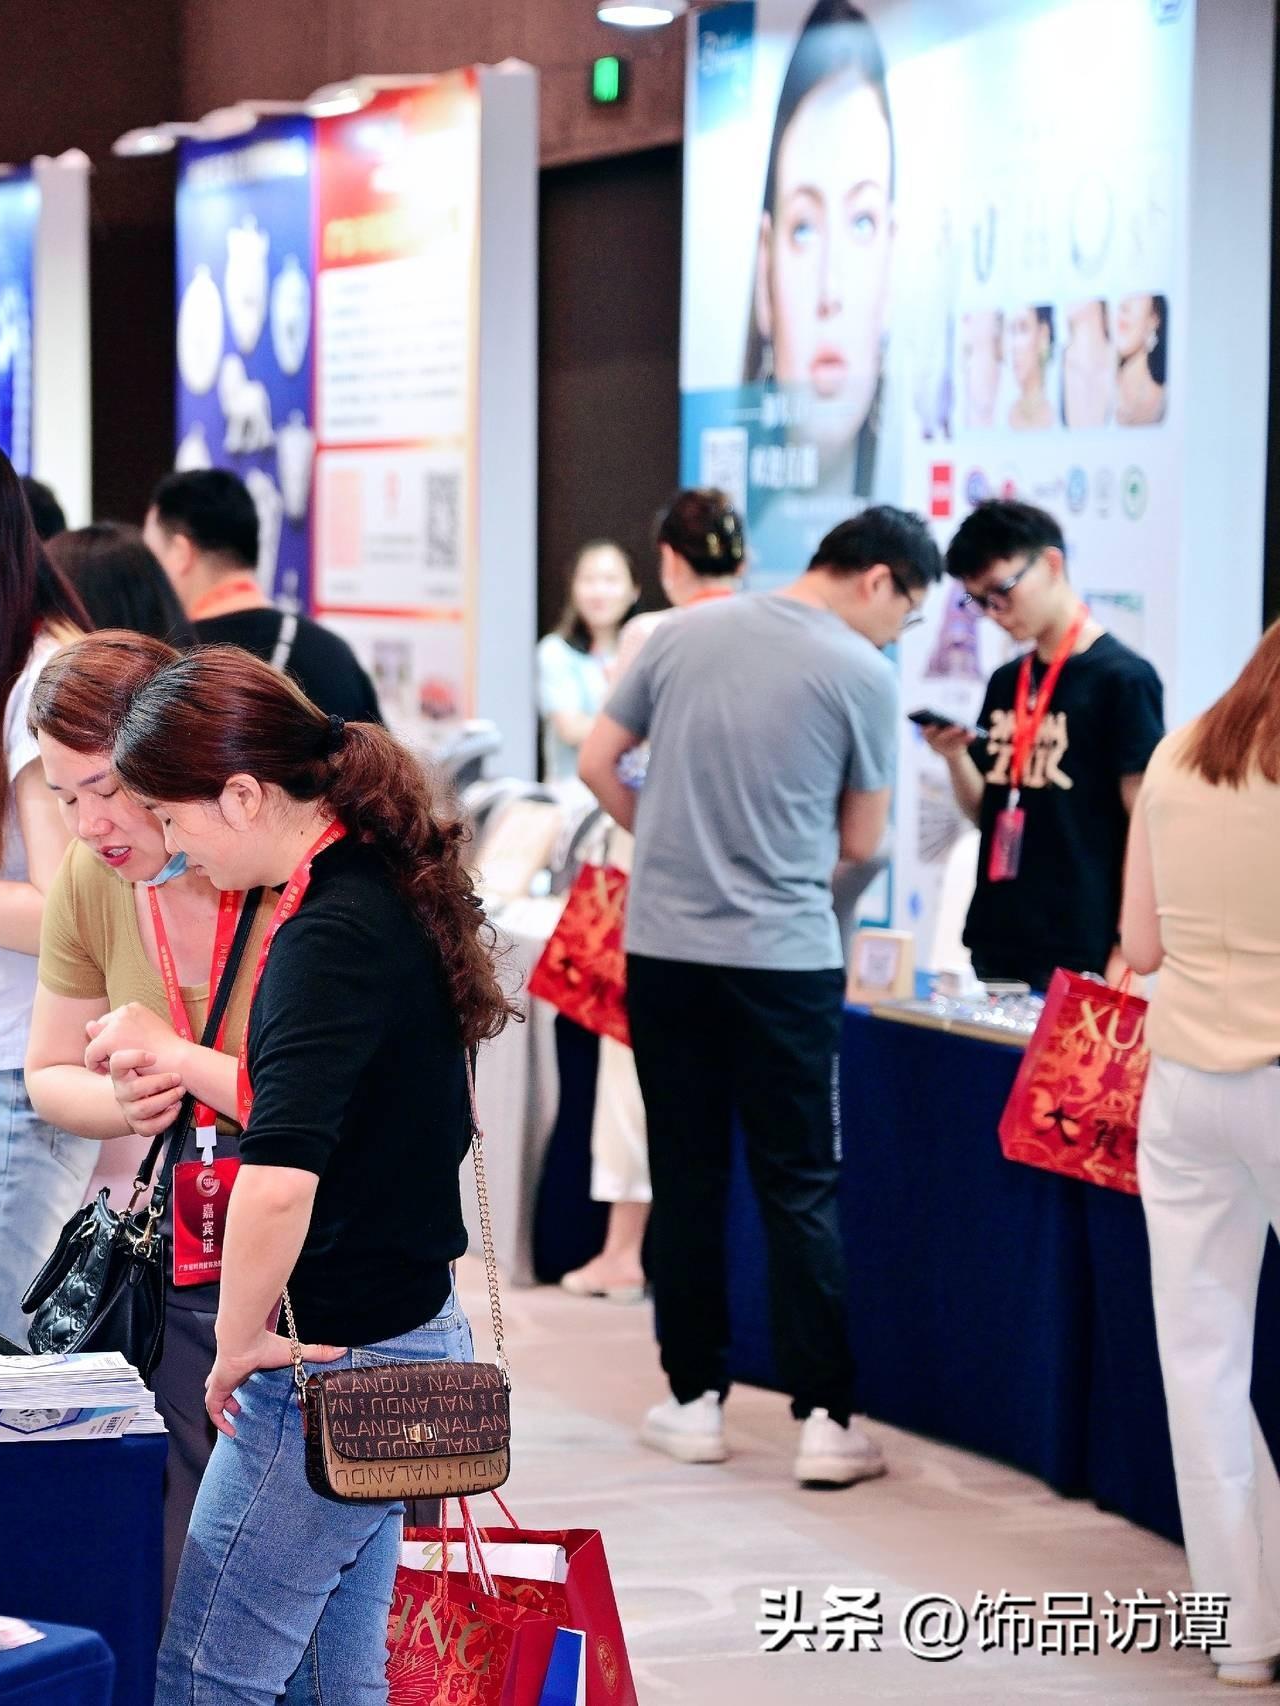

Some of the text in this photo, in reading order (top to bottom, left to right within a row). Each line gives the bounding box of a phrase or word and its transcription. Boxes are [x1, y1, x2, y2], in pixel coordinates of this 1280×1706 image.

[202, 1203, 214, 1254] 嘉宾证
[392, 1594, 495, 1675] ING
